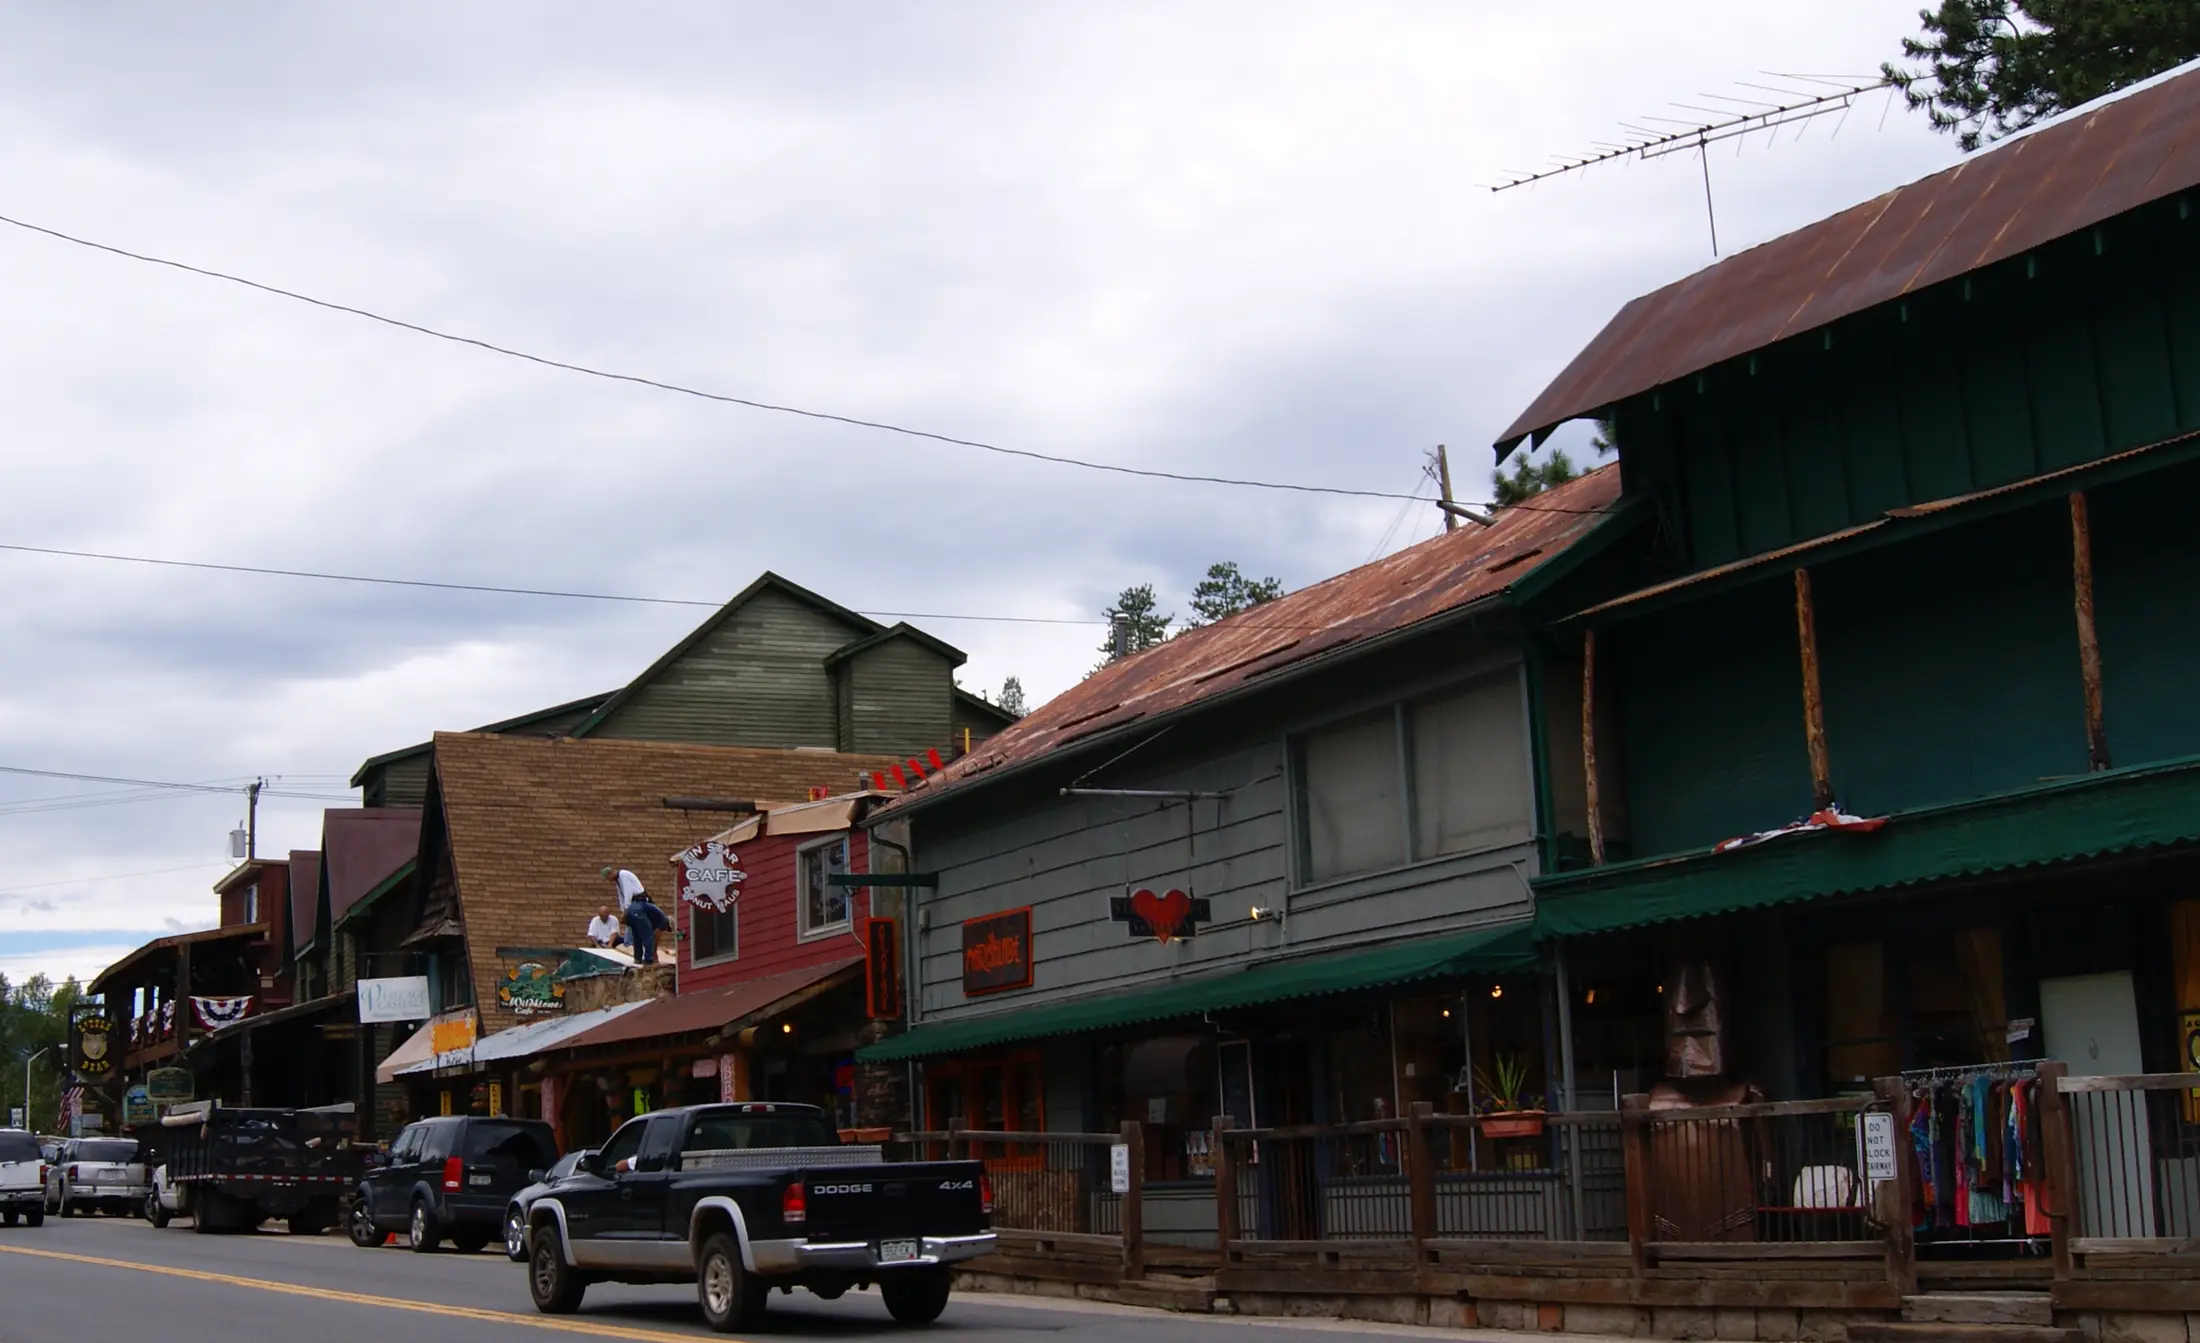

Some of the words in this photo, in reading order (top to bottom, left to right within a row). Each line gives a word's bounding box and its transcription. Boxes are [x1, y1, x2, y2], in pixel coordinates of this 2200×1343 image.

[684, 845, 703, 864] TIN
[707, 843, 739, 864] STAR
[685, 869, 741, 882] CAFE
[1869, 1123, 1880, 1132] DO
[1867, 1136, 1884, 1144] NOT
[1867, 1149, 1891, 1158] LOCK
[814, 1184, 872, 1195] DODGE
